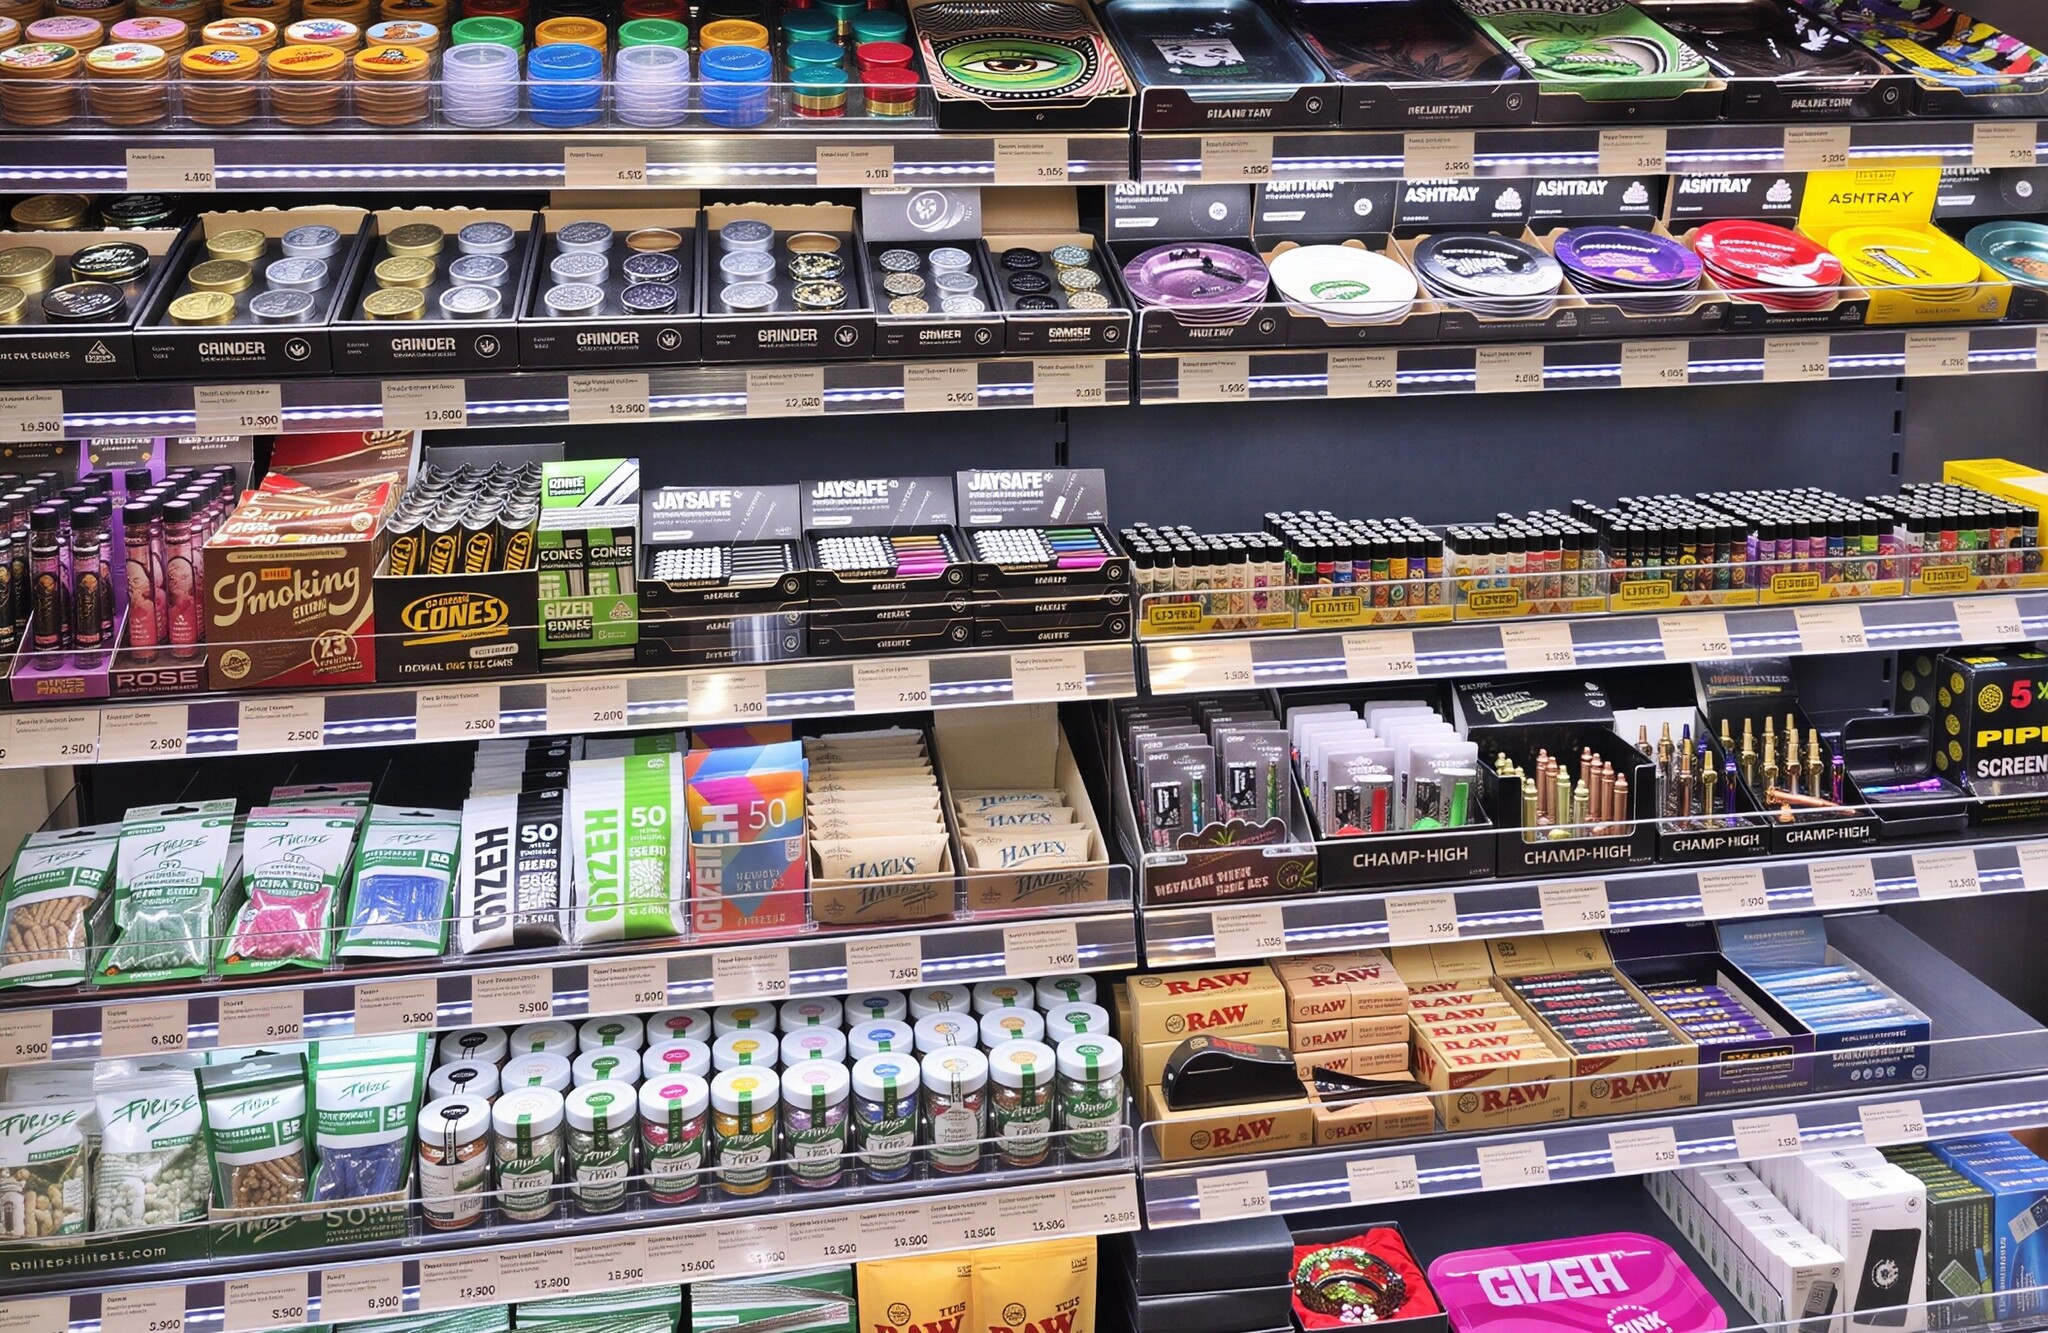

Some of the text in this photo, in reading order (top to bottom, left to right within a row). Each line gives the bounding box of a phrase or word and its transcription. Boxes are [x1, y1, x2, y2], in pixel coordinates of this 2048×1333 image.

[1405, 186, 1480, 203] ASHTRAY
[1536, 180, 1609, 196] ASHTRAY
[1679, 177, 1752, 195] ASHTRAY
[1828, 191, 1914, 205] ASHTRAY
[391, 337, 456, 352] GRINDER
[576, 331, 640, 347] GRINDER
[757, 328, 818, 343] GRINDER
[198, 341, 266, 356] GRINDER
[812, 479, 889, 499] JAYSAFE
[967, 472, 1043, 490] JAYSAFE
[652, 490, 732, 510] JAYSAFE
[213, 566, 360, 627] Smoking
[414, 598, 501, 632] CONES
[117, 670, 198, 687] ROSE
[2010, 680, 2032, 709] 5
[631, 805, 667, 827] 50
[749, 799, 787, 830] 50
[521, 823, 558, 843] 50
[1786, 825, 1870, 844] CHAMP-HIGH
[1352, 846, 1469, 868] CHAMP-HIGH
[1524, 844, 1632, 865] CHAMP-HIGH
[1164, 971, 1252, 996] RAW
[1307, 967, 1381, 988] RAW
[1311, 999, 1346, 1015] RAW
[1410, 994, 1474, 1009] RAW
[1186, 1004, 1249, 1032] RAW
[1312, 1029, 1348, 1046] RAW
[1432, 1021, 1498, 1037] RAW
[1611, 1070, 1673, 1099] RAW
[1481, 1079, 1553, 1113] RAW
[1212, 1117, 1277, 1148] RAW
[1336, 1121, 1373, 1138] RAW
[1478, 1253, 1630, 1307] GIZEH
